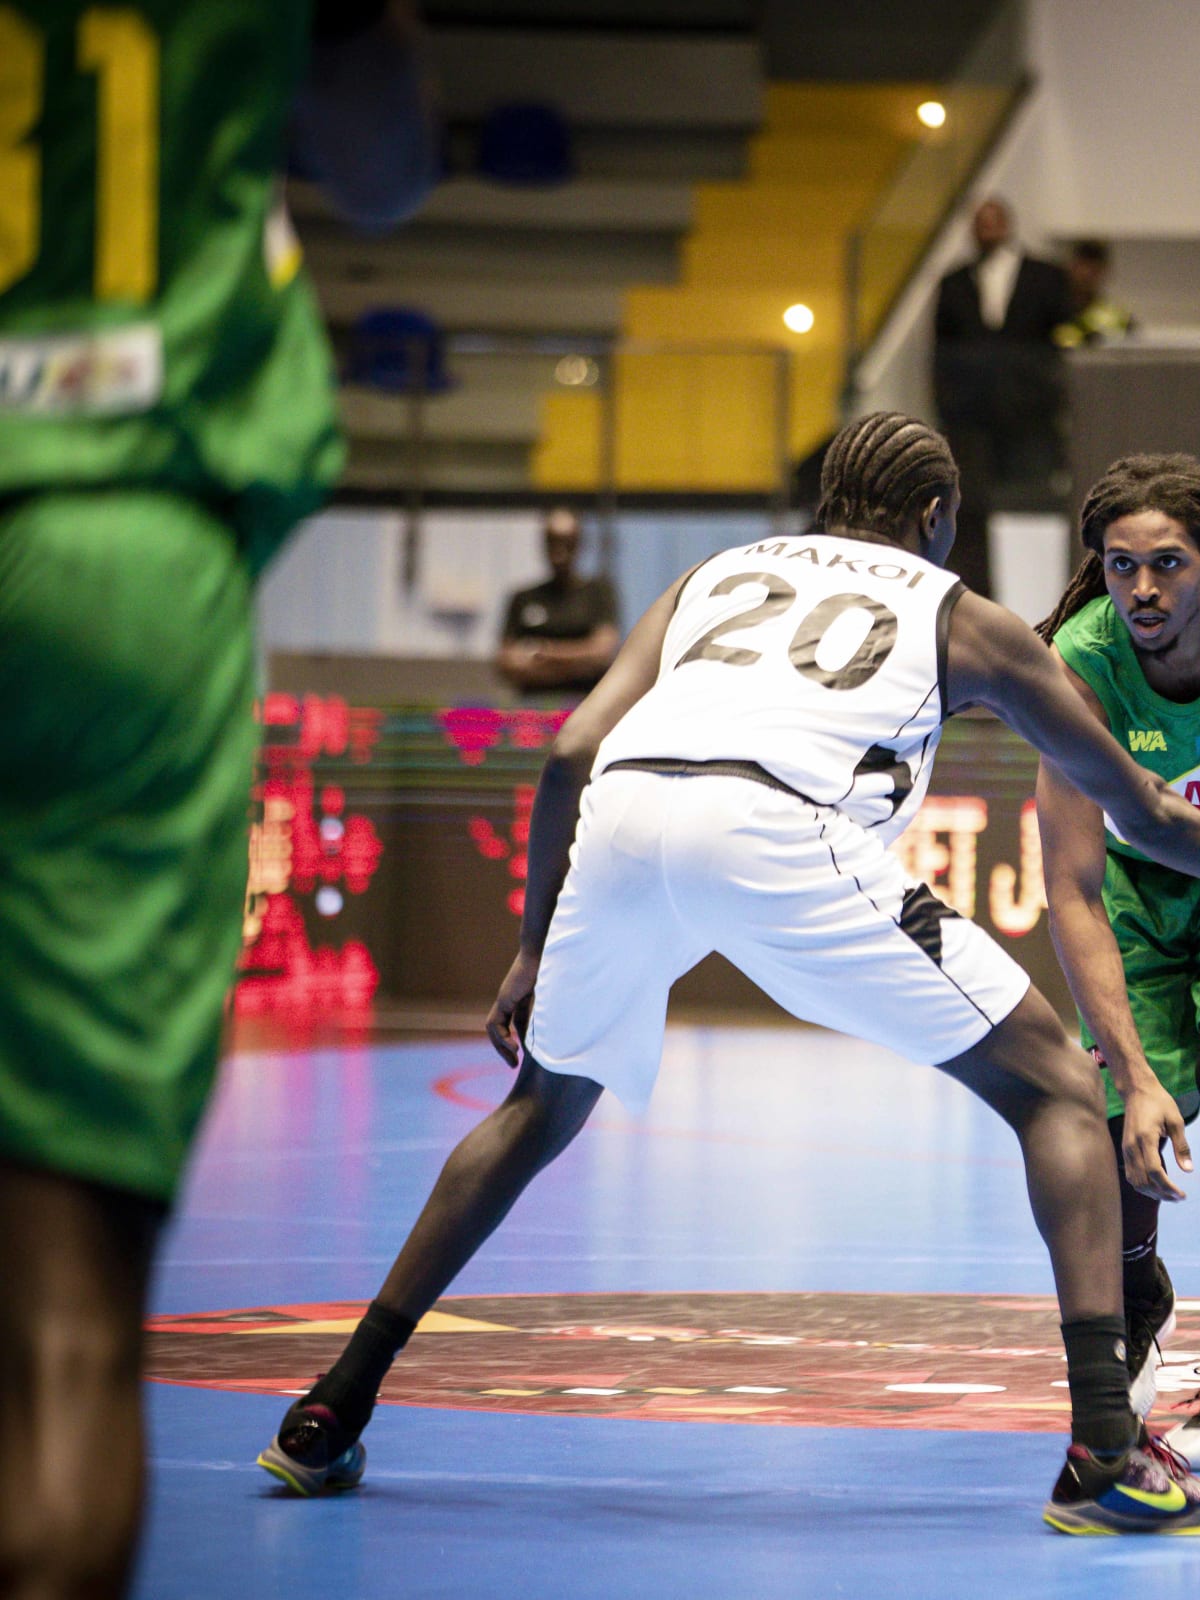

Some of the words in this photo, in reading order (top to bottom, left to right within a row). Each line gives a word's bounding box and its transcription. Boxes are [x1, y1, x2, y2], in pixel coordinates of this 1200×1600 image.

[743, 542, 925, 590] MAKOI
[674, 571, 897, 690] 20
[1128, 731, 1167, 751] WA
